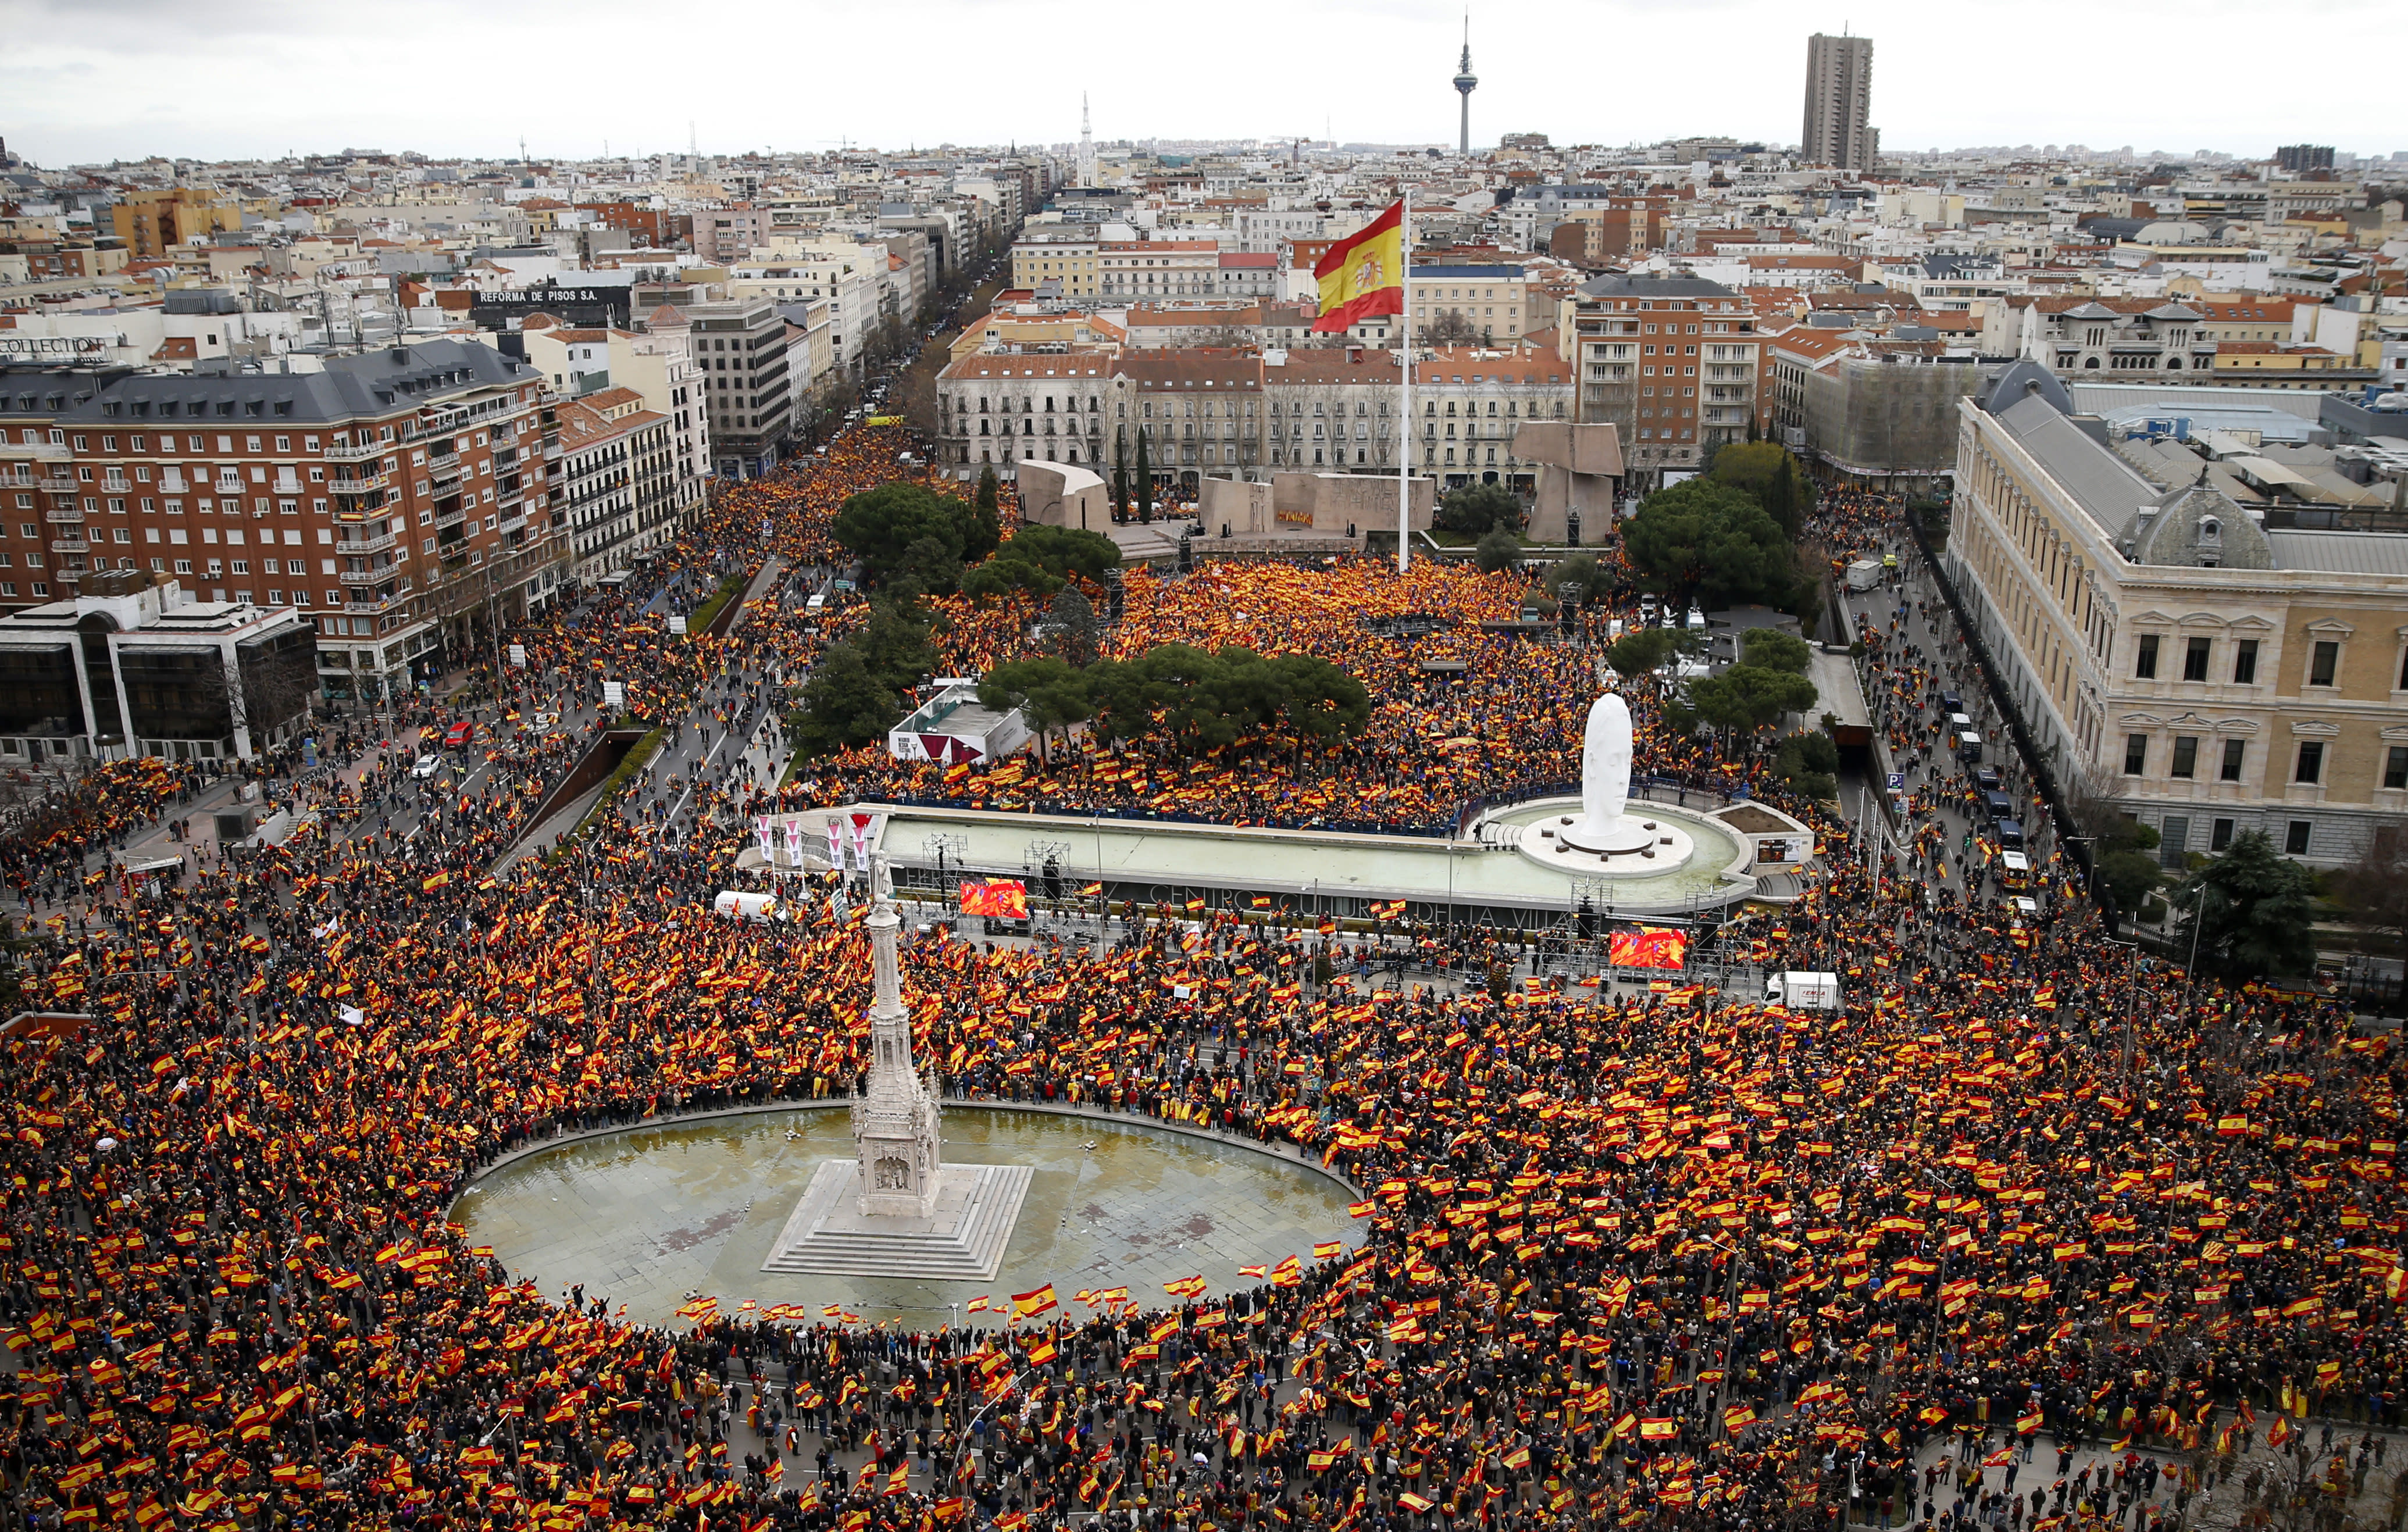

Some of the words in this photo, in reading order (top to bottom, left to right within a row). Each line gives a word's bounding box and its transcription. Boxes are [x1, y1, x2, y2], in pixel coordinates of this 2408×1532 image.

[480, 292, 526, 302] REFORMA
[531, 291, 543, 301] DE
[548, 291, 576, 301] PISOS
[580, 290, 597, 301] S.A.
[0, 338, 101, 352] COLLECTION
[1889, 775, 1898, 786] P
